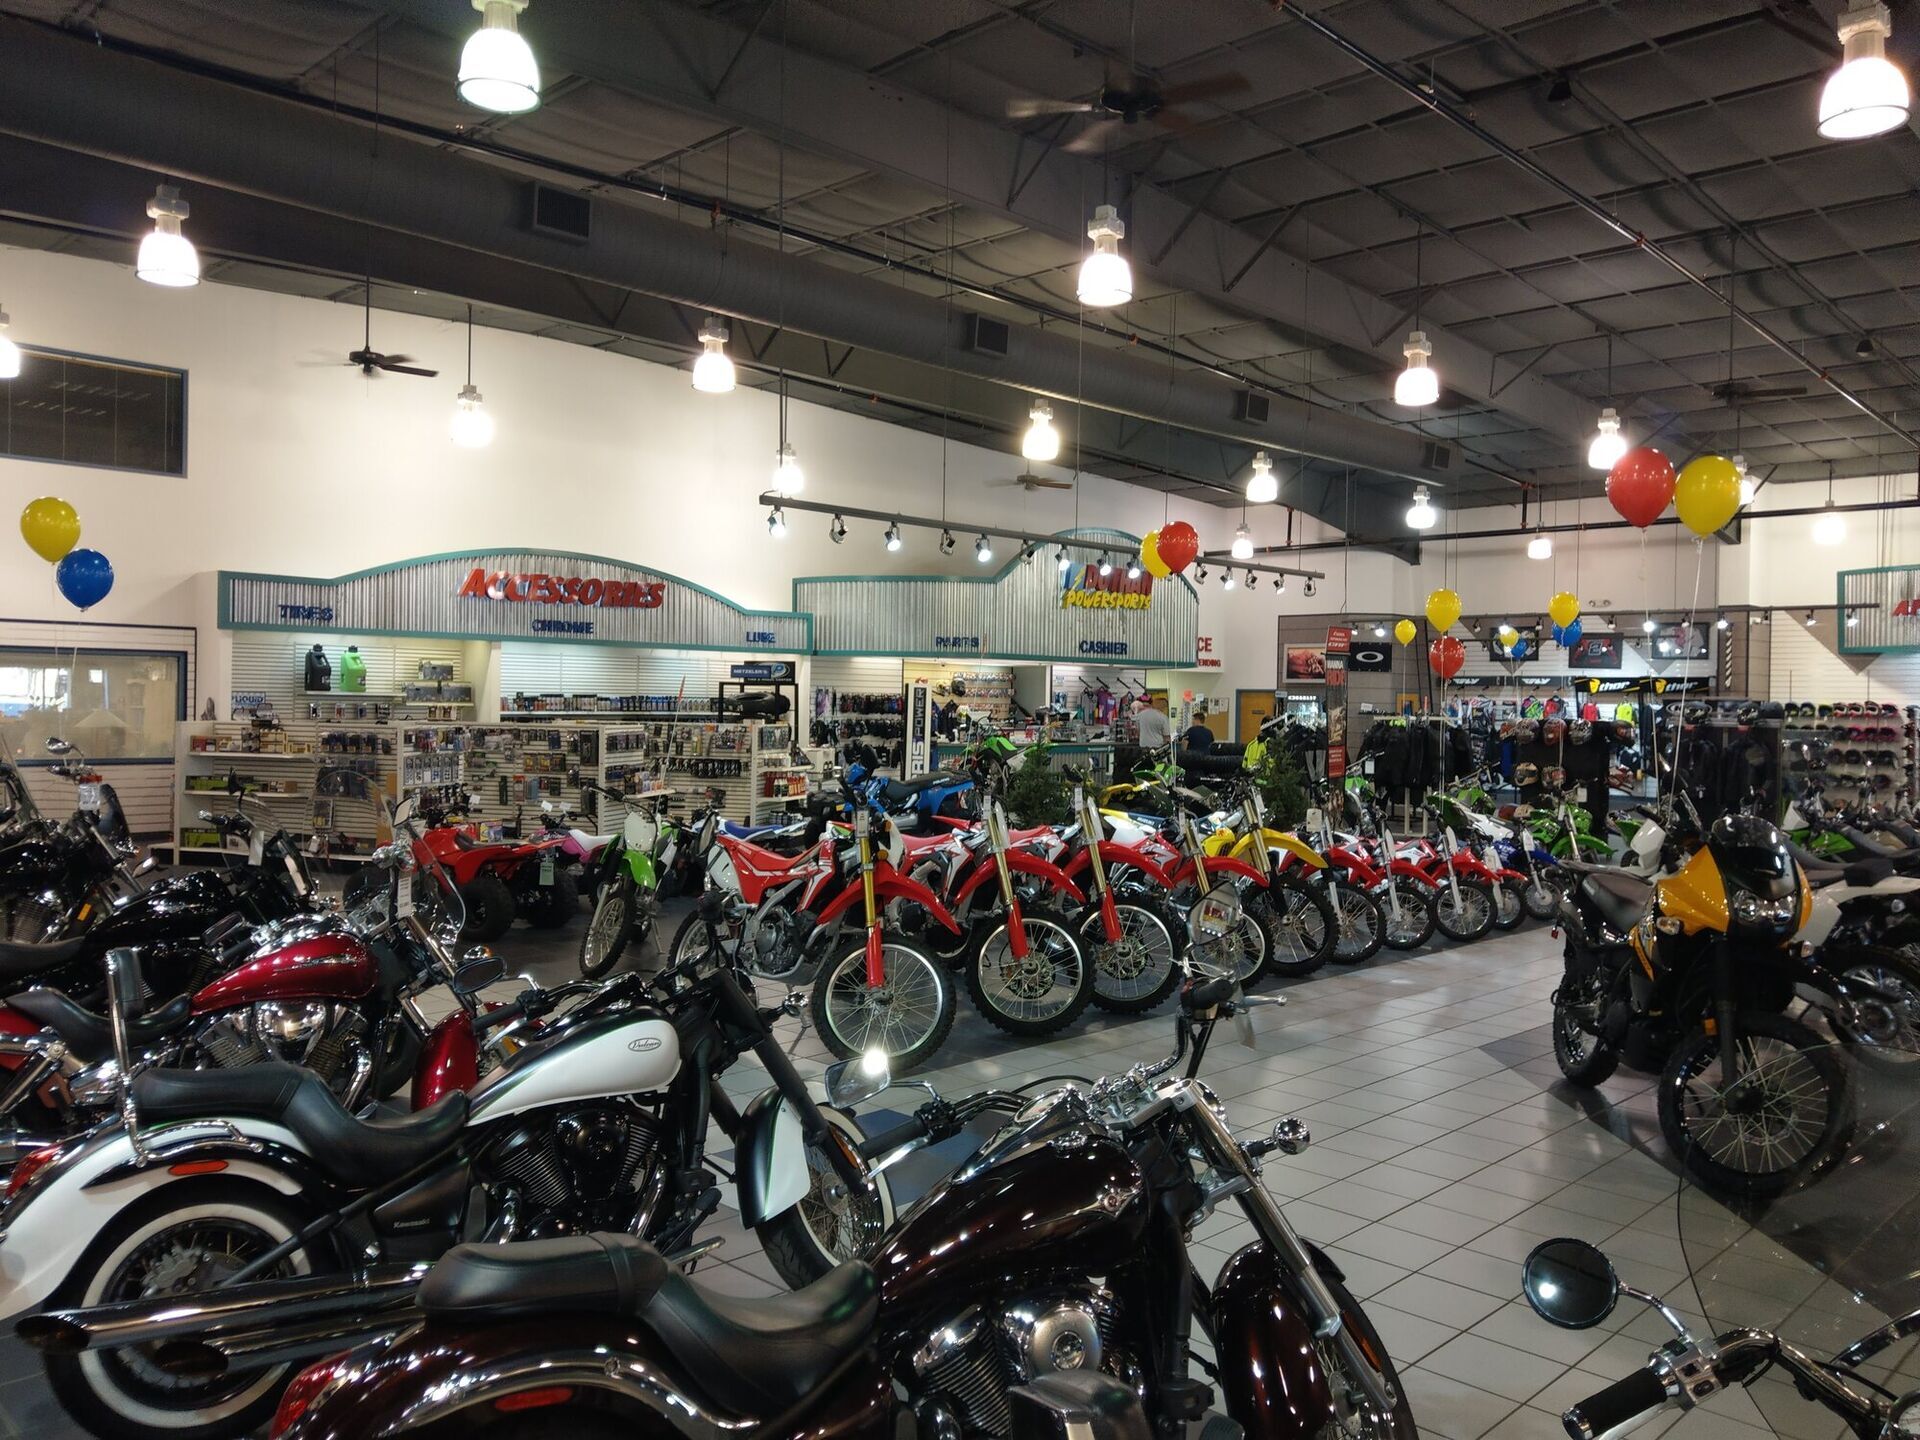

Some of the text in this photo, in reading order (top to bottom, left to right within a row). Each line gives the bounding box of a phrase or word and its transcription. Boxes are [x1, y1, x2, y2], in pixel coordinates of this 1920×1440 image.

[459, 568, 665, 608] ACCESSORIES
[1065, 589, 1152, 609] POWERSPORTS
[278, 604, 334, 622] TIRES
[532, 619, 594, 634] CHROME
[936, 636, 979, 648] PARTS
[1080, 640, 1128, 655] CASHIER
[1599, 681, 1631, 692] thor
[915, 688, 925, 736] POWER
